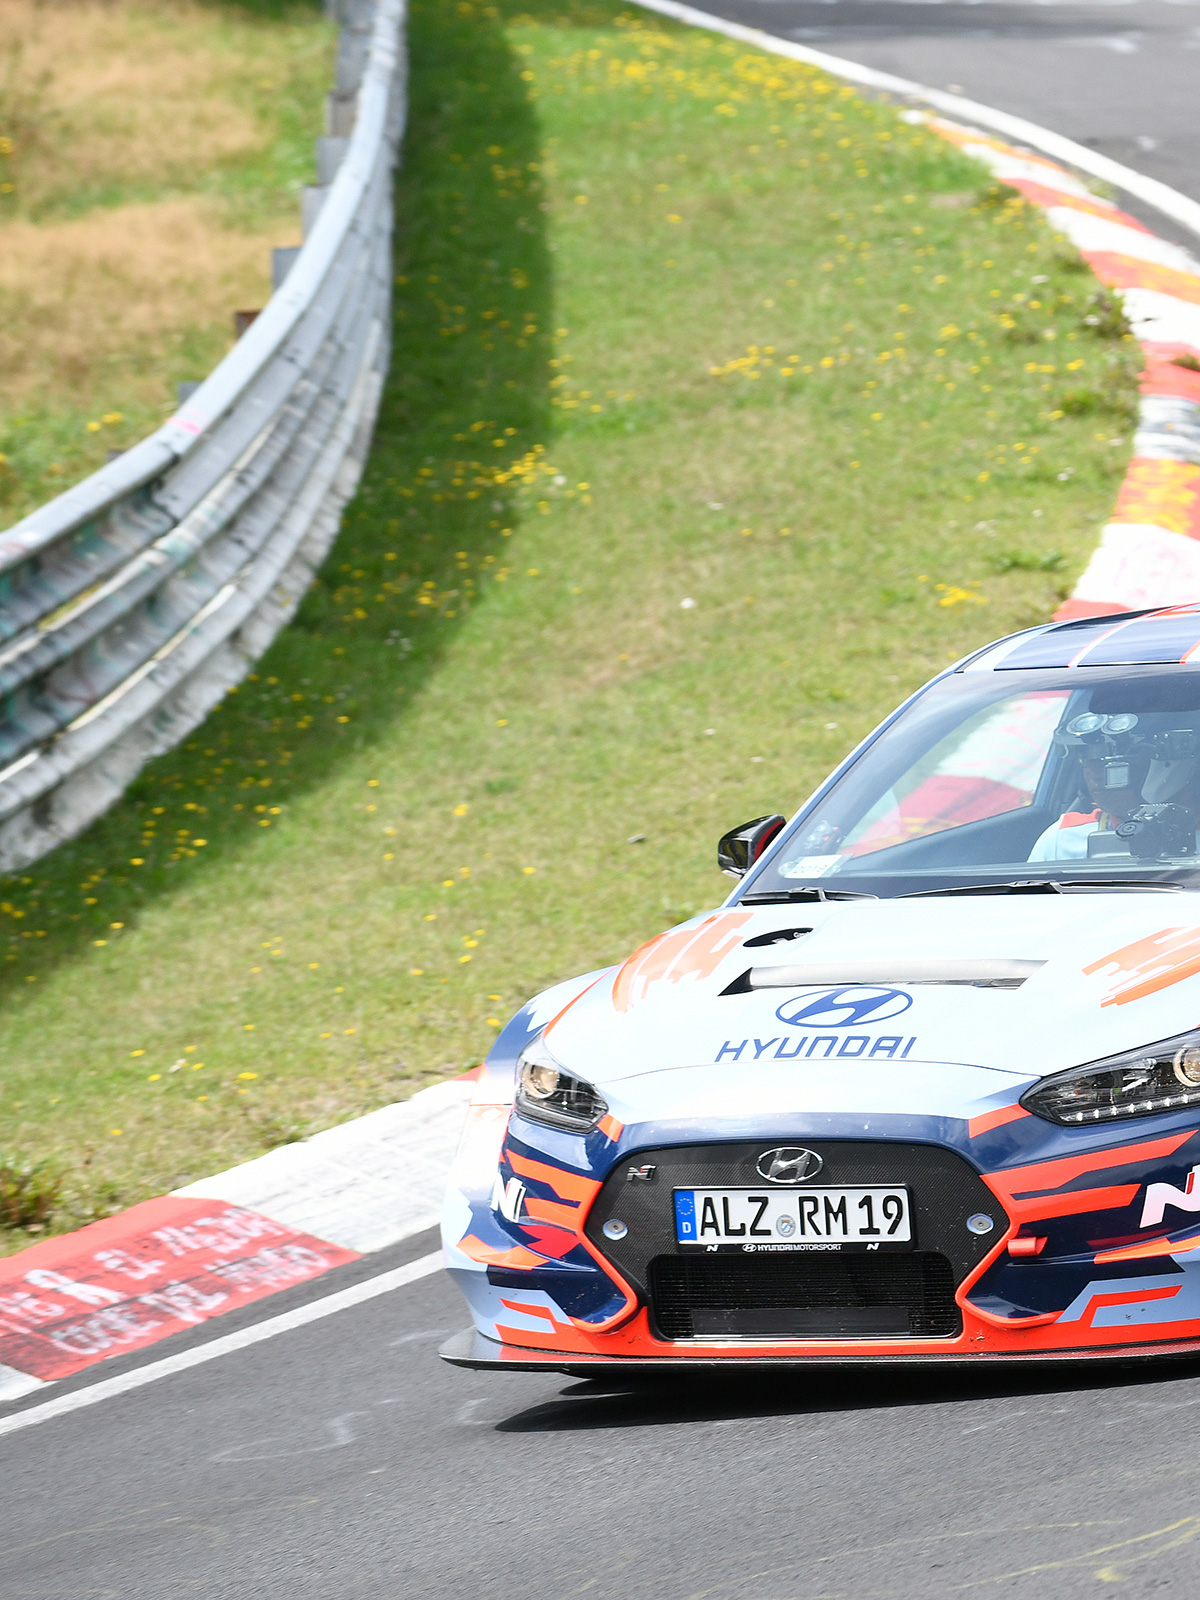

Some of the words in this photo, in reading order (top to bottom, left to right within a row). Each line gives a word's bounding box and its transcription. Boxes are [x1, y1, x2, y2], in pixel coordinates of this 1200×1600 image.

[713, 1035, 917, 1063] HYUNDAI
[682, 1221, 691, 1233] D
[700, 1195, 772, 1237] ALZ
[798, 1195, 848, 1236] RM
[858, 1194, 904, 1236] 19
